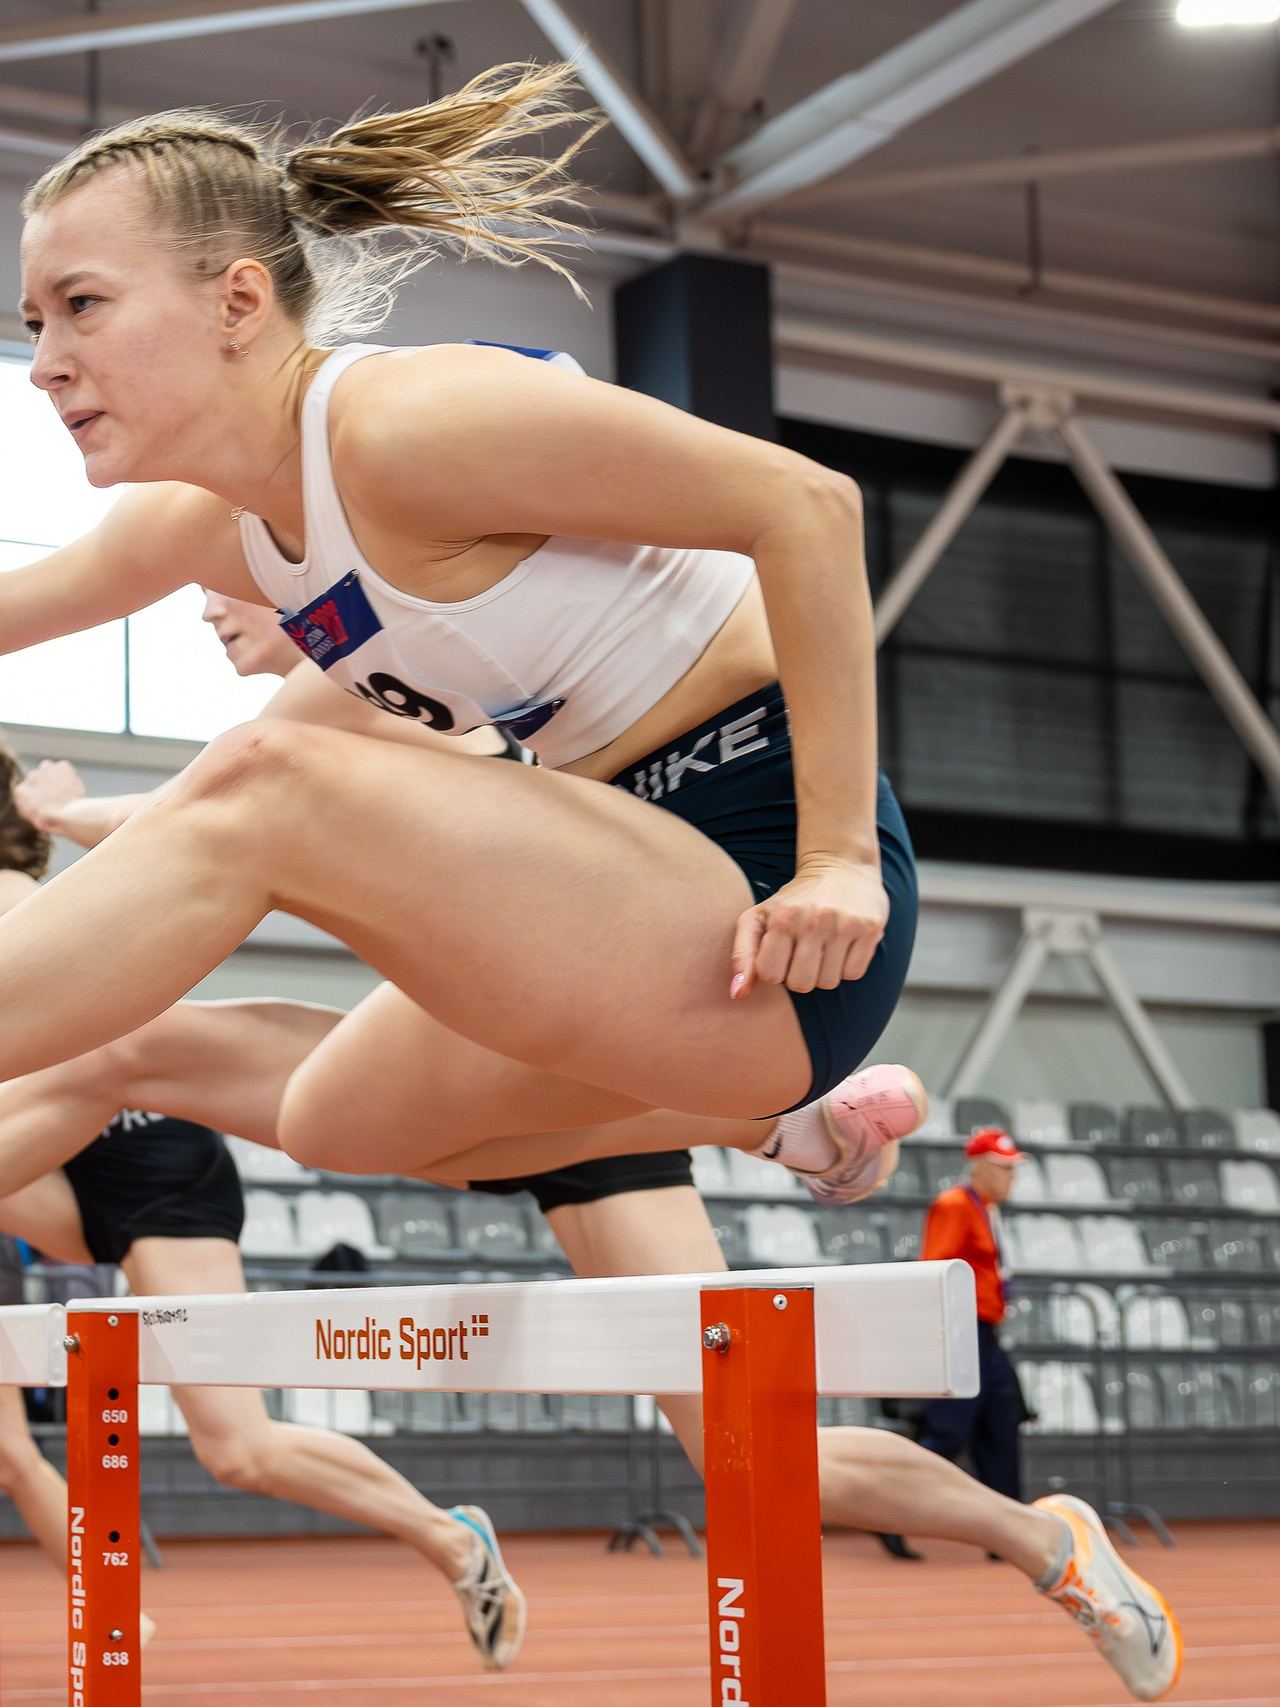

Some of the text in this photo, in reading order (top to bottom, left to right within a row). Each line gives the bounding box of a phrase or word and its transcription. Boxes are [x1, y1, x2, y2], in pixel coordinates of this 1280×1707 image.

[316, 1317, 469, 1371] Nordic Sport
[102, 1409, 128, 1423] 650
[102, 1454, 129, 1469] 686
[102, 1552, 129, 1566] 762
[70, 1506, 86, 1630] Nordic
[717, 1577, 750, 1707] Nord
[102, 1651, 129, 1666] 838
